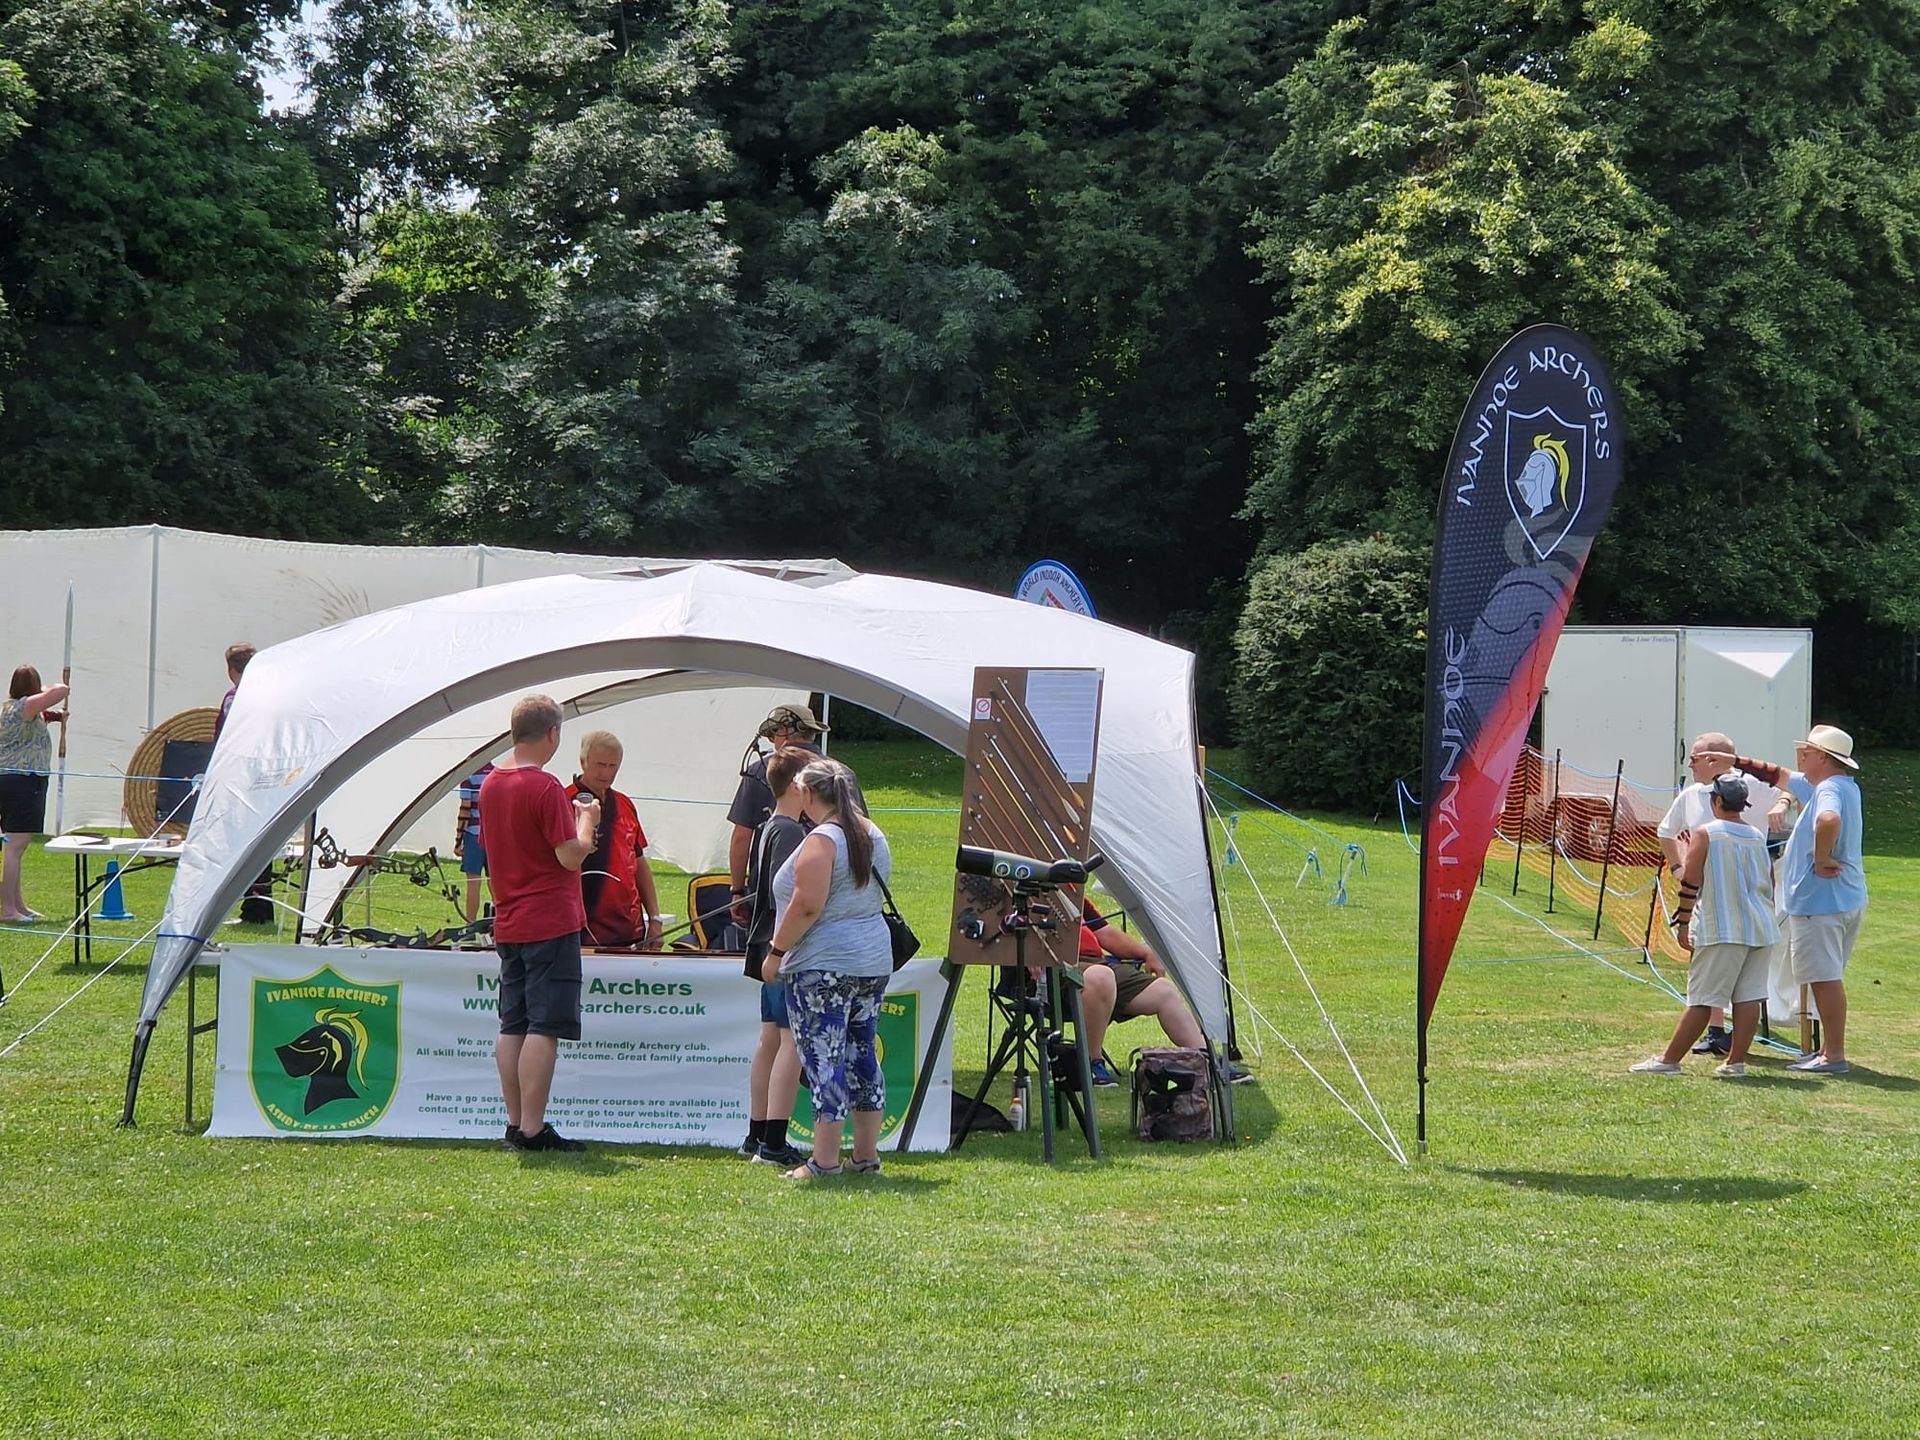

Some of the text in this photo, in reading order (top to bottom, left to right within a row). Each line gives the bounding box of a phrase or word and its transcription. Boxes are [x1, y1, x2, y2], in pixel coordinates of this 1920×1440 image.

[589, 977, 692, 996] Archers
[266, 986, 389, 1006] IVANHOE ARCHERS
[457, 1038, 473, 1046] We
[576, 1041, 592, 1050] yet
[595, 1041, 636, 1051] friendly
[639, 1041, 681, 1052] Archery
[684, 1042, 710, 1051] club.
[416, 1048, 430, 1056] All
[432, 1048, 454, 1057] skill
[457, 1048, 488, 1058] levels
[563, 1053, 614, 1061] welcome.
[617, 1053, 646, 1061] Great
[650, 1053, 683, 1064] family
[685, 1054, 752, 1064] atmosphere.
[426, 1093, 452, 1102] Have
[465, 1095, 477, 1104] go
[553, 1096, 600, 1106] beginner
[602, 1098, 645, 1106] courses
[648, 1099, 666, 1107] are
[669, 1099, 717, 1107] available
[720, 1099, 741, 1109] just
[418, 1104, 458, 1113] contact
[477, 1105, 496, 1114] and
[587, 1110, 600, 1118] go
[638, 1110, 683, 1118] website.
[726, 1111, 747, 1119] also
[458, 1118, 471, 1126] on
[566, 1120, 580, 1128] for
